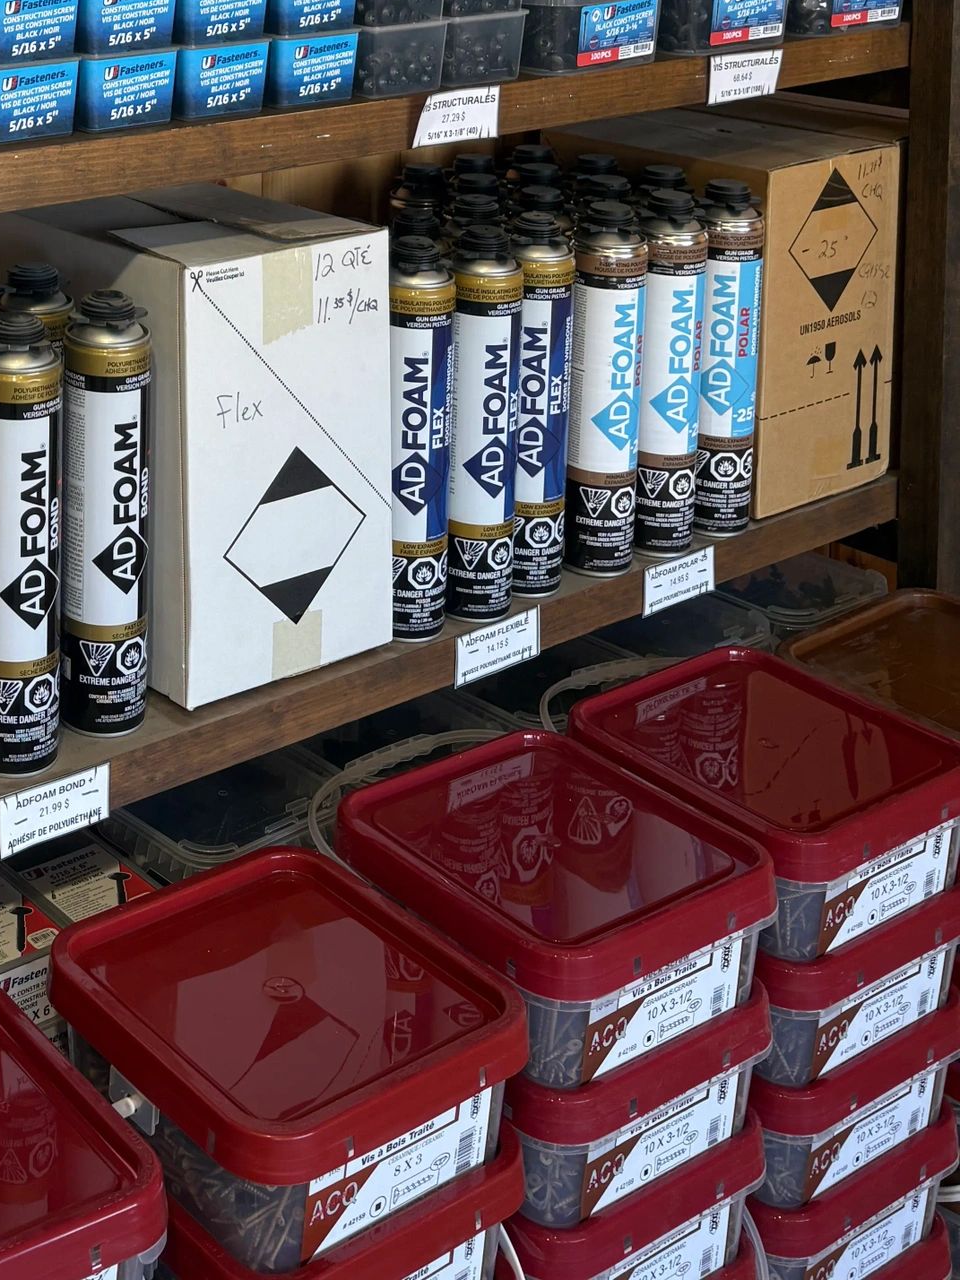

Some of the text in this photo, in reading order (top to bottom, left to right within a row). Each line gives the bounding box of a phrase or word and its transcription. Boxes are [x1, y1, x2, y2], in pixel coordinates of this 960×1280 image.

[714, 57, 779, 71] VIS STRUCTURALES
[433, 95, 496, 110] STRUCTURALES
[442, 113, 460, 123] 27.29
[315, 253, 334, 281] 12
[738, 306, 750, 358] POLAR
[799, 310, 861, 335] UN1950 AEROSOLS
[707, 274, 737, 407] ADFOAM
[518, 327, 547, 467] ADFOAM
[550, 375, 562, 415] FLEX
[216, 392, 264, 430] Flex
[651, 566, 677, 580] ADFOAM
[678, 558, 698, 570] POLAR
[465, 618, 529, 648] ADFOAM FLEXIBLE
[487, 640, 504, 653] 14.15
[16, 788, 56, 810] ADFOAM
[58, 778, 86, 795] BOND
[40, 799, 70, 818] 21.99 $
[8, 807, 102, 850] ADHÉSIF DE POLYURÉTHANE
[647, 990, 693, 1020] 10 X 3-1/2
[361, 1154, 374, 1166] Vis
[386, 1139, 406, 1152] Bois
[409, 1121, 435, 1140] Traité
[394, 1153, 422, 1176] 8 X 3
[309, 1182, 359, 1226] ACQ
